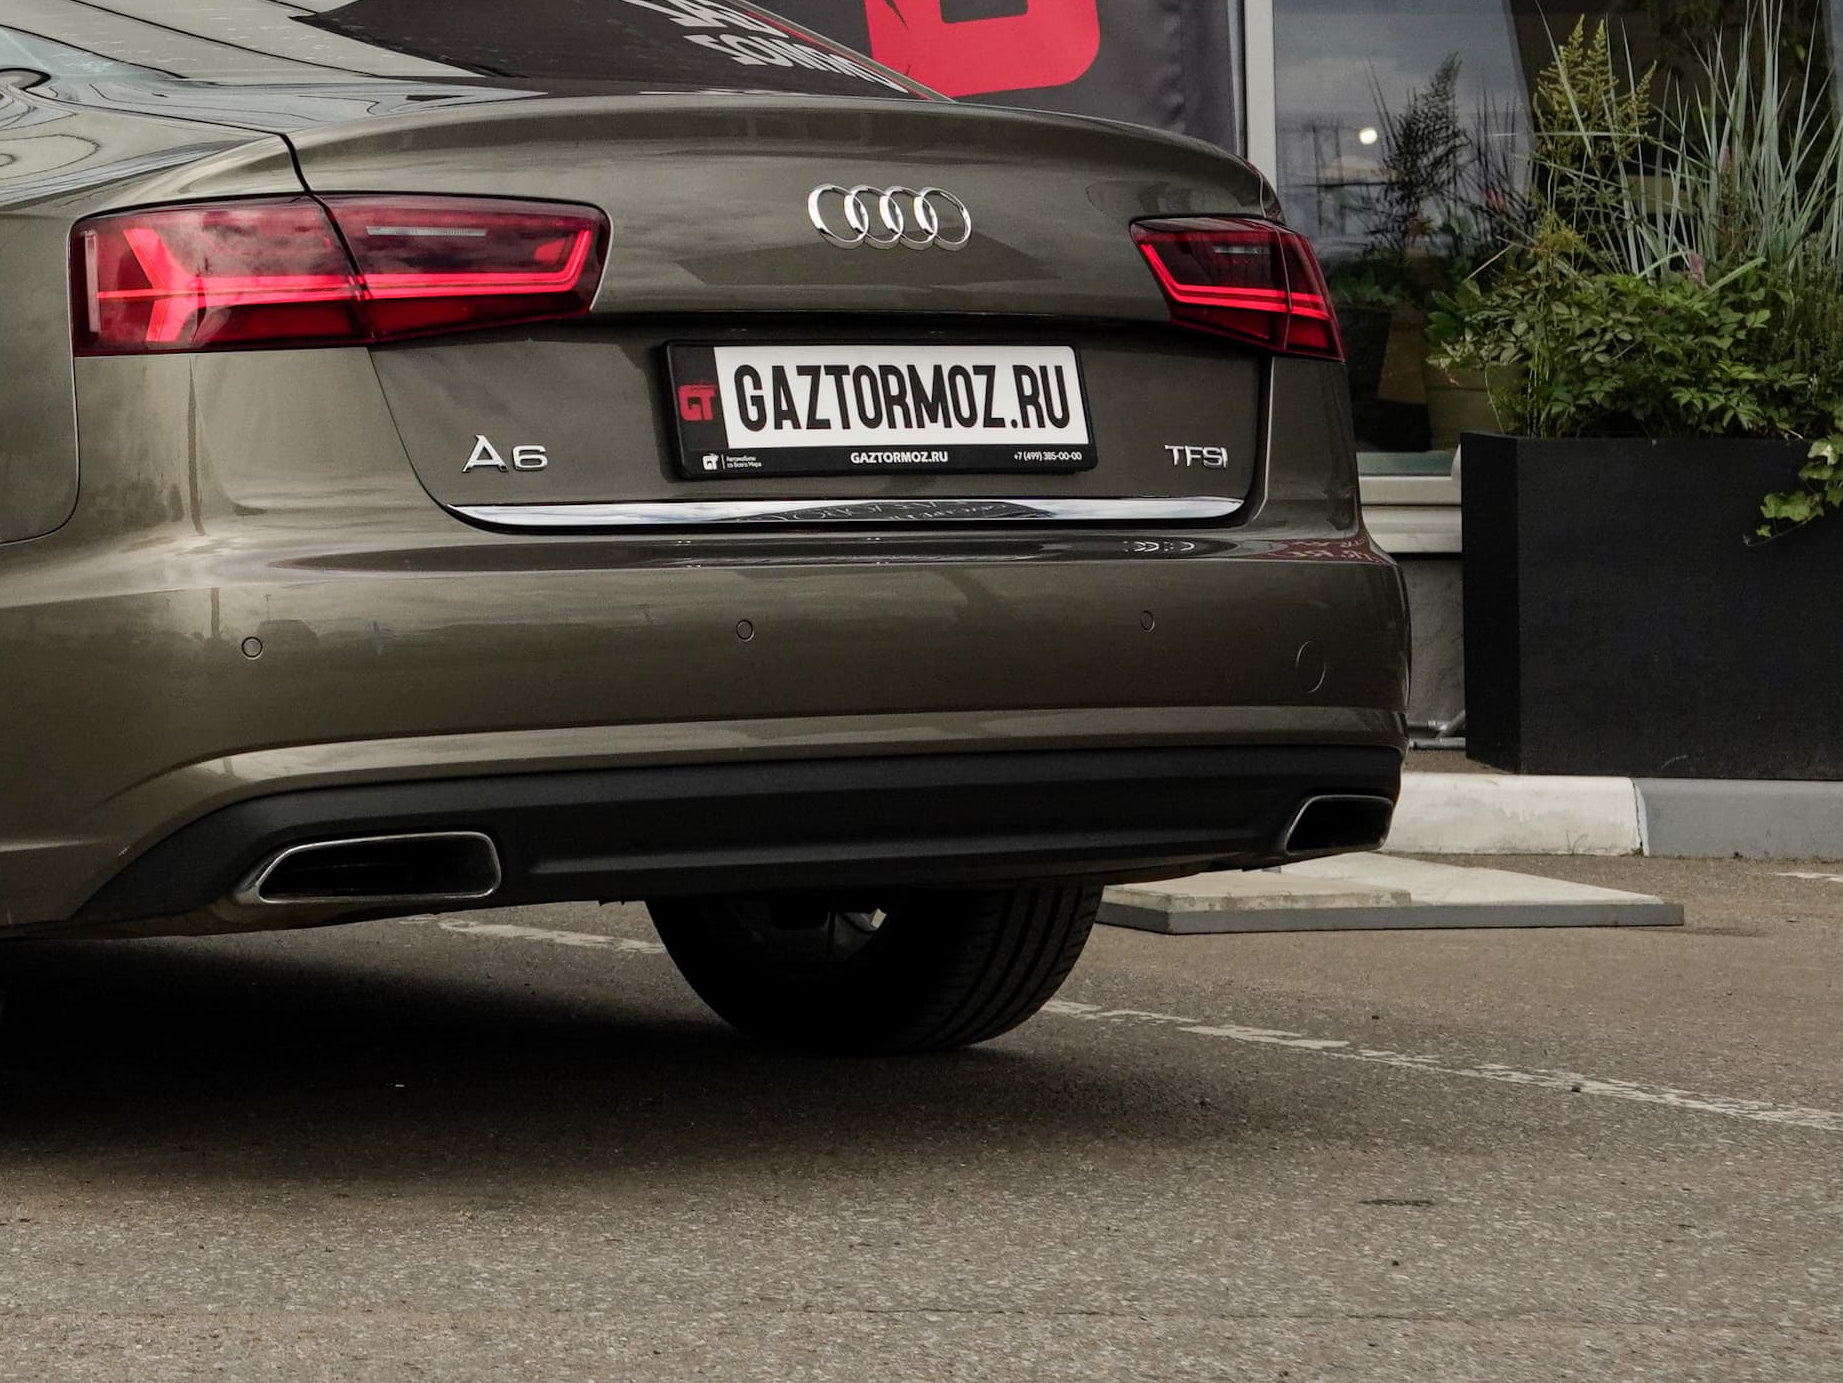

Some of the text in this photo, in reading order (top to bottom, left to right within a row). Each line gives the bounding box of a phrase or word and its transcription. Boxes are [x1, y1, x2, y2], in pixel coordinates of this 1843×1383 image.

[733, 363, 1071, 433] GAZTORMOZ.RU
[461, 434, 549, 472] A6
[850, 451, 949, 465] GAZTORMOZ.RU
[1163, 444, 1229, 469] TFSI
